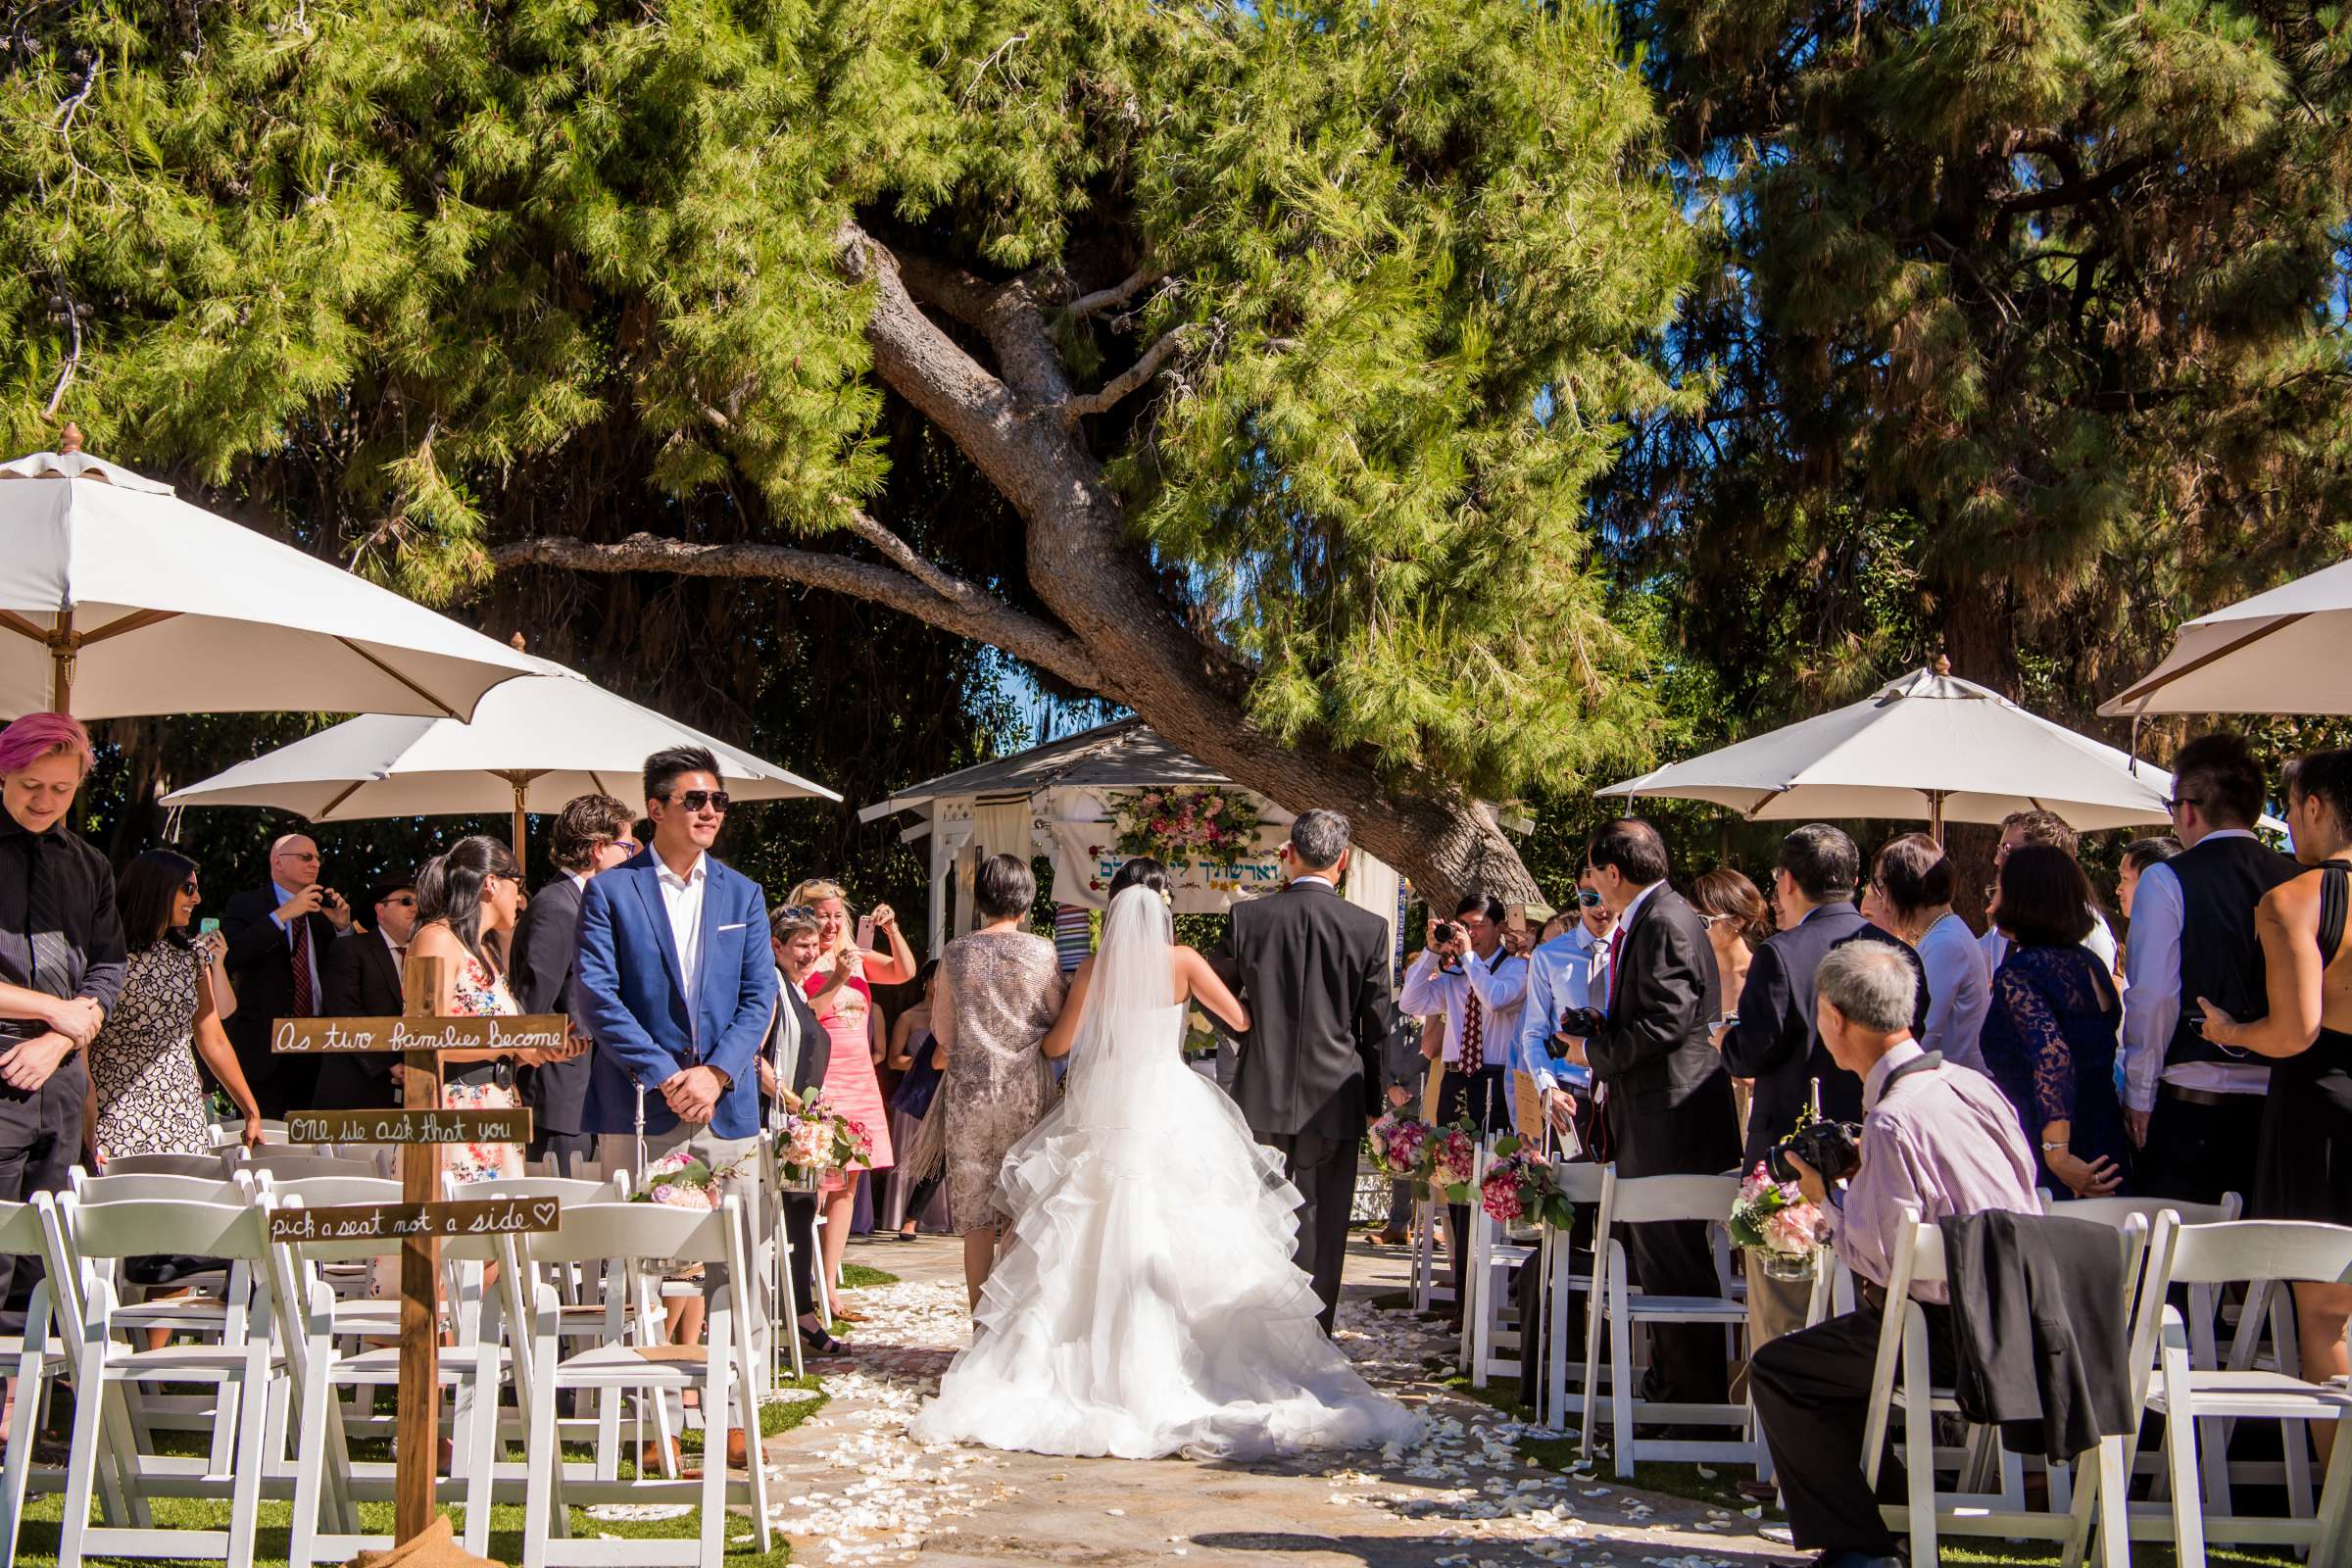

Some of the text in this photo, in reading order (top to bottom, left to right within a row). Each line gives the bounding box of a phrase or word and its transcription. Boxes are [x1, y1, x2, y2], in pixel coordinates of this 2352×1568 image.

[276, 1019, 562, 1052] As two families become
[339, 1120, 368, 1141] we
[375, 1113, 414, 1141] ask
[418, 1112, 467, 1143] that
[478, 1122, 512, 1143] you
[271, 1201, 532, 1243] pick a seat not a side
